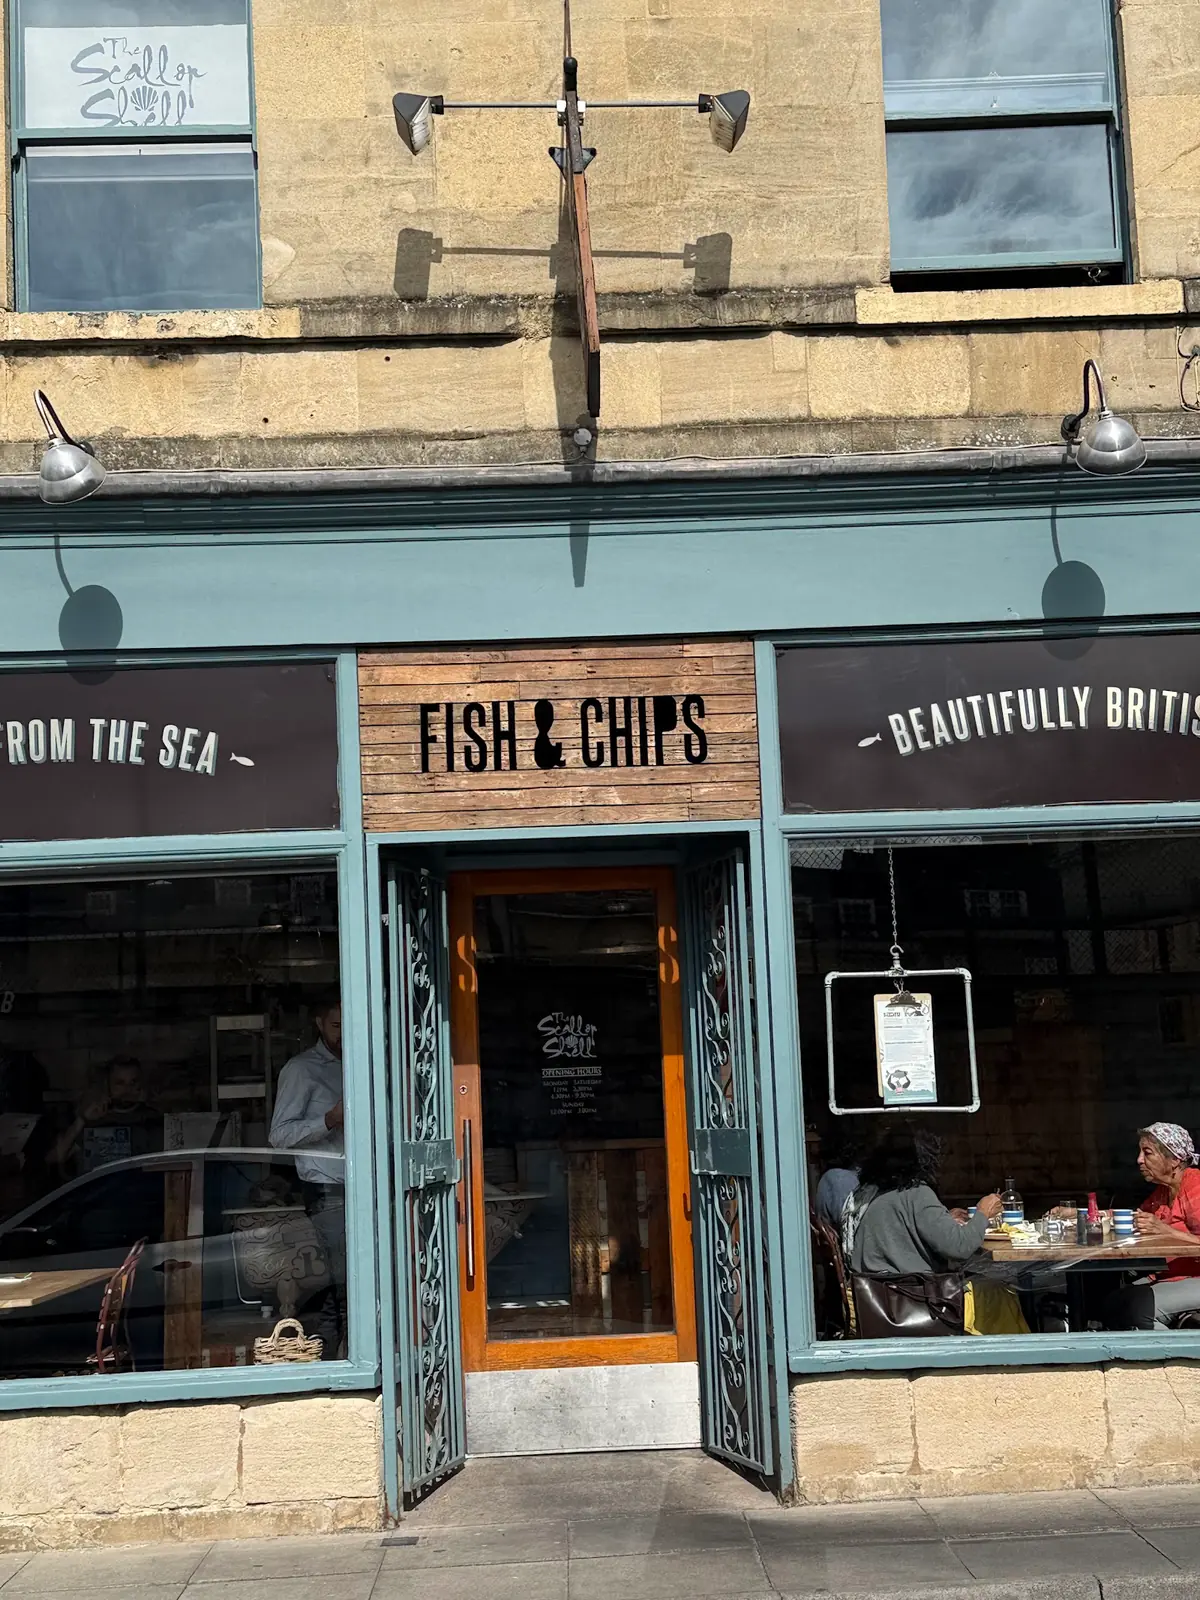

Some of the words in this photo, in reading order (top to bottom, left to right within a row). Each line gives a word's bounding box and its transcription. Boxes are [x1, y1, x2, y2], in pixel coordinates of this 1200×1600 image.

[71, 43, 207, 109] Scallop
[103, 37, 141, 59] The
[80, 86, 187, 127] Shell
[0, 718, 76, 765] ROM
[90, 718, 149, 765] THE
[159, 724, 219, 776] SEA
[421, 701, 517, 773] FISH
[534, 699, 566, 769] &
[581, 695, 708, 768] CHIPS
[888, 686, 1093, 756] BEAUTIFULLY
[542, 1068, 575, 1077] OPENING
[577, 1067, 602, 1076] HOURS
